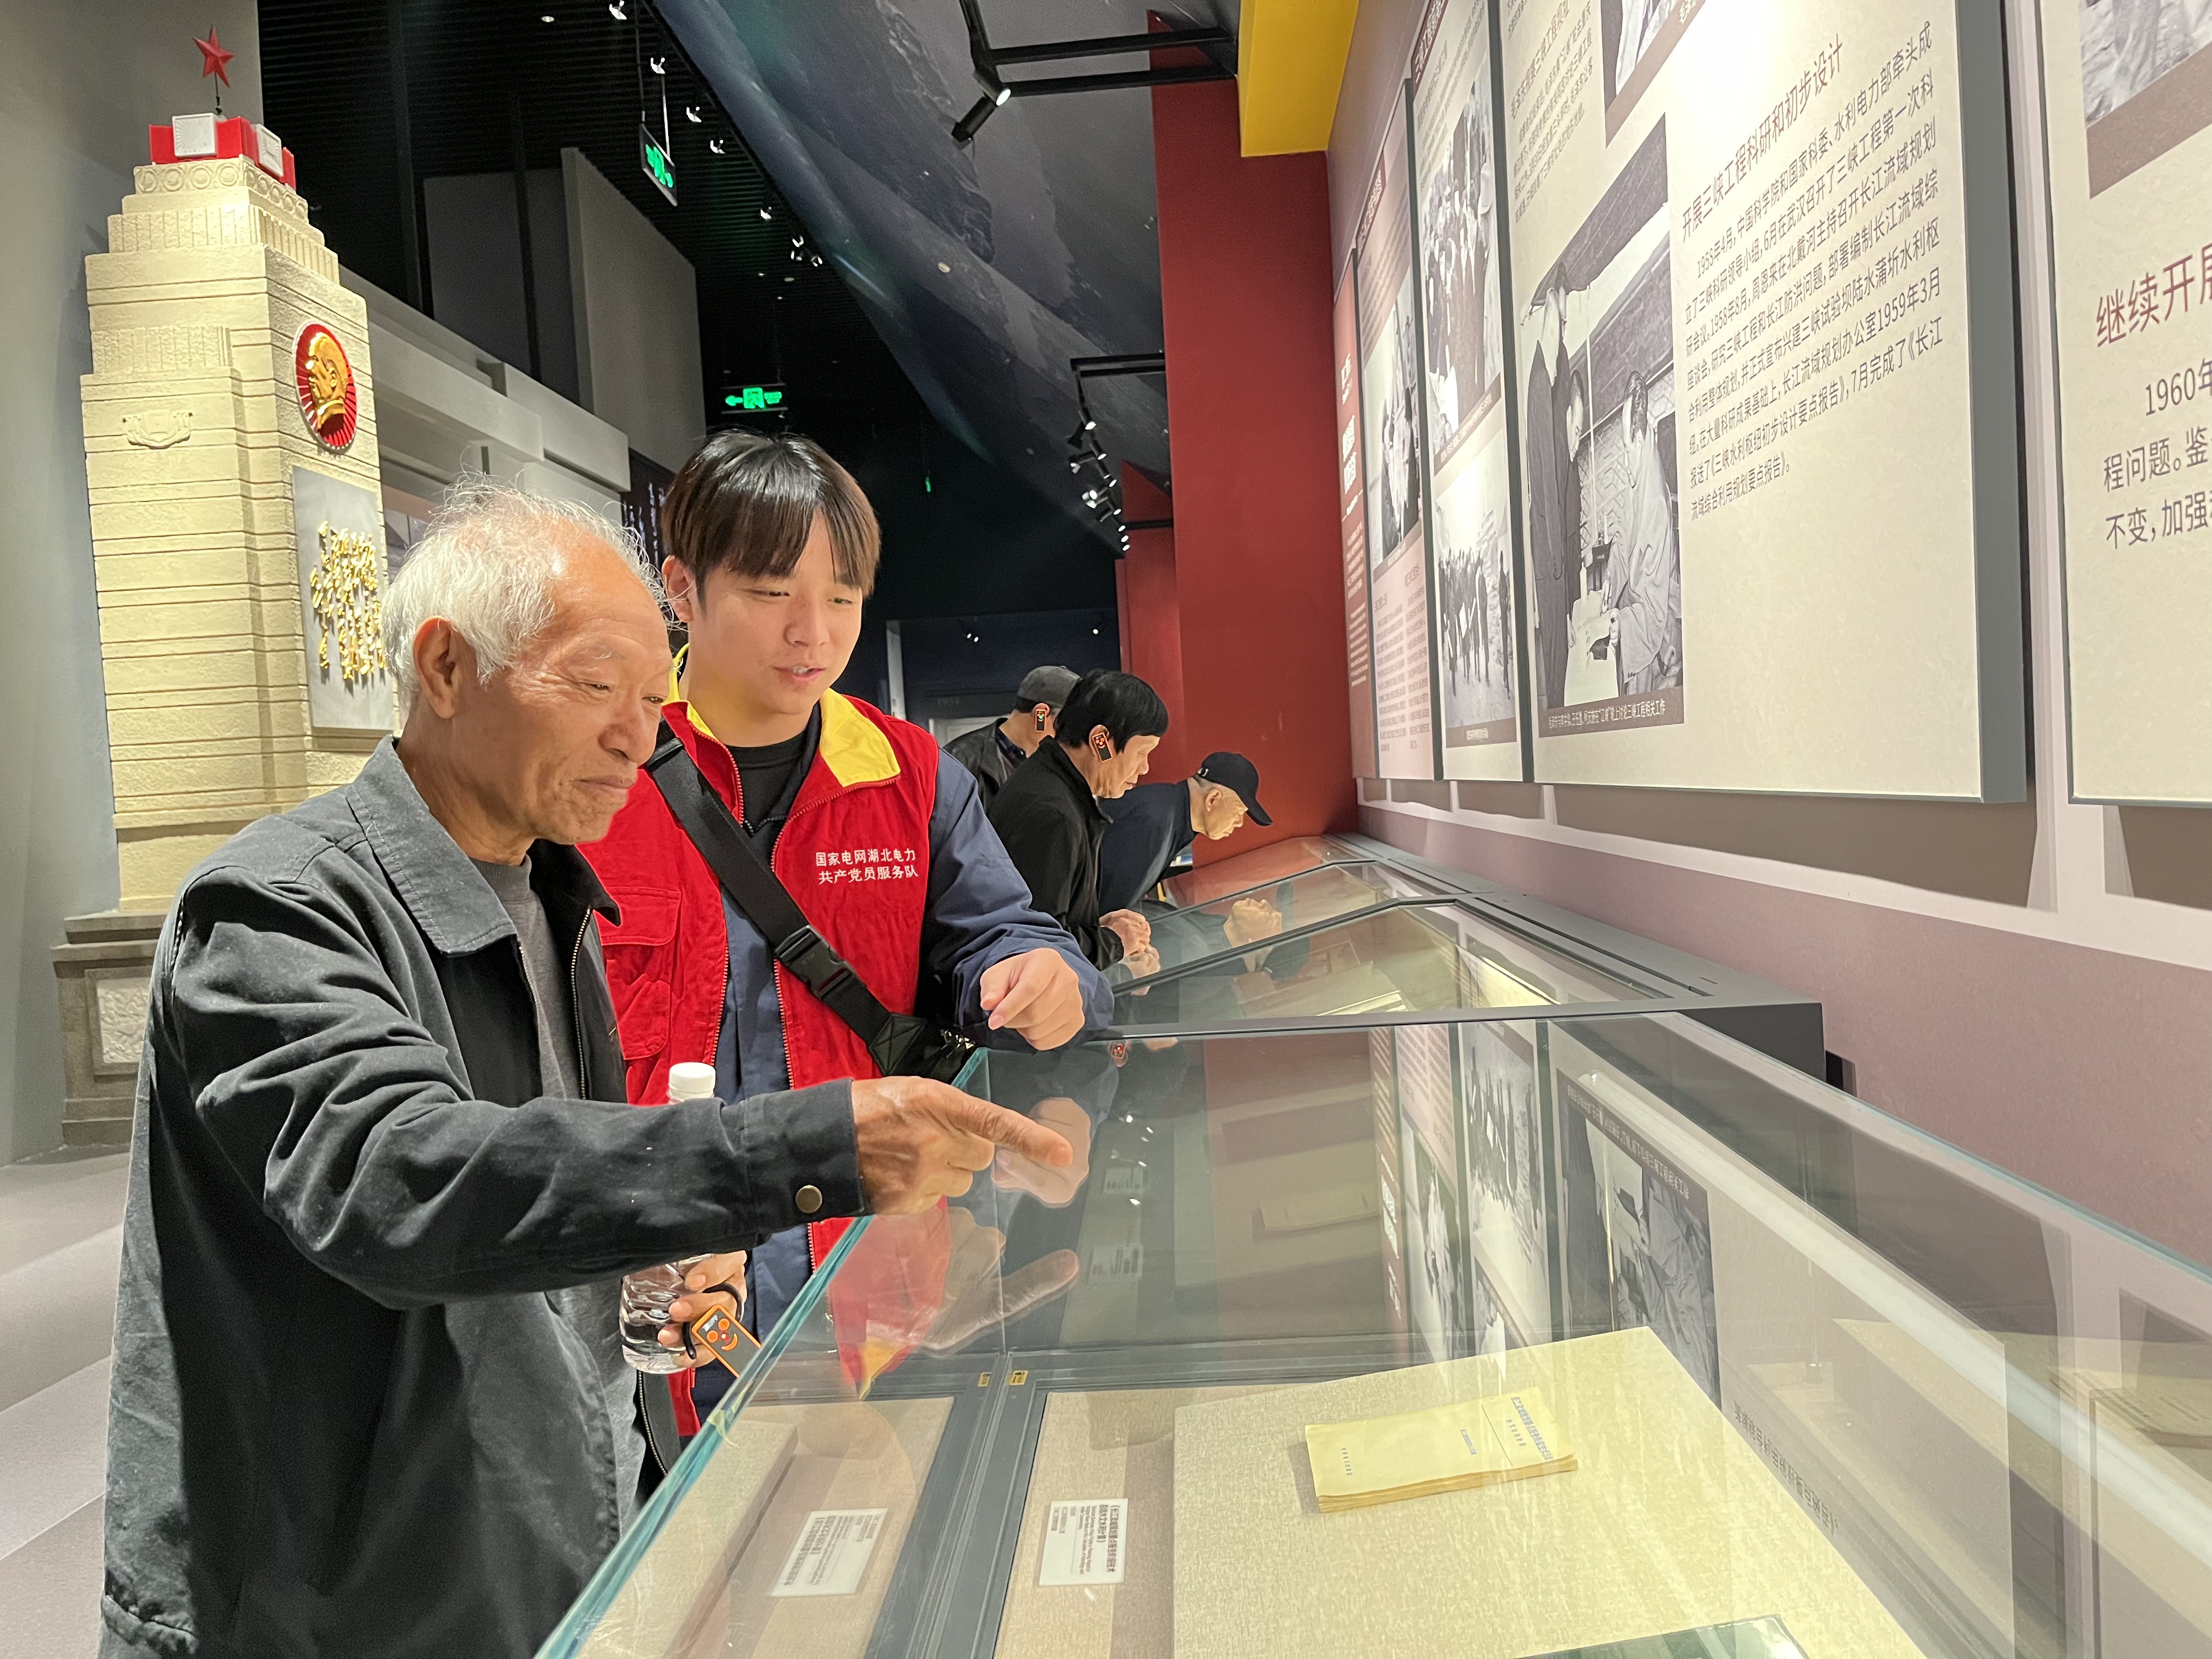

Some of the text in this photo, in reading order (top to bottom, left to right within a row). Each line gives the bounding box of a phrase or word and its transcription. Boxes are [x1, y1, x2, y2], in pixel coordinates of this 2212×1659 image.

[1683, 33, 1842, 242] 开展三峡工程科研和初步设计
[2146, 358, 2211, 416] 1960年
[2106, 490, 2211, 549] 不变，加强
[816, 848, 916, 867] 国家电网湖北电力
[819, 865, 918, 884] 共产党员服务队
